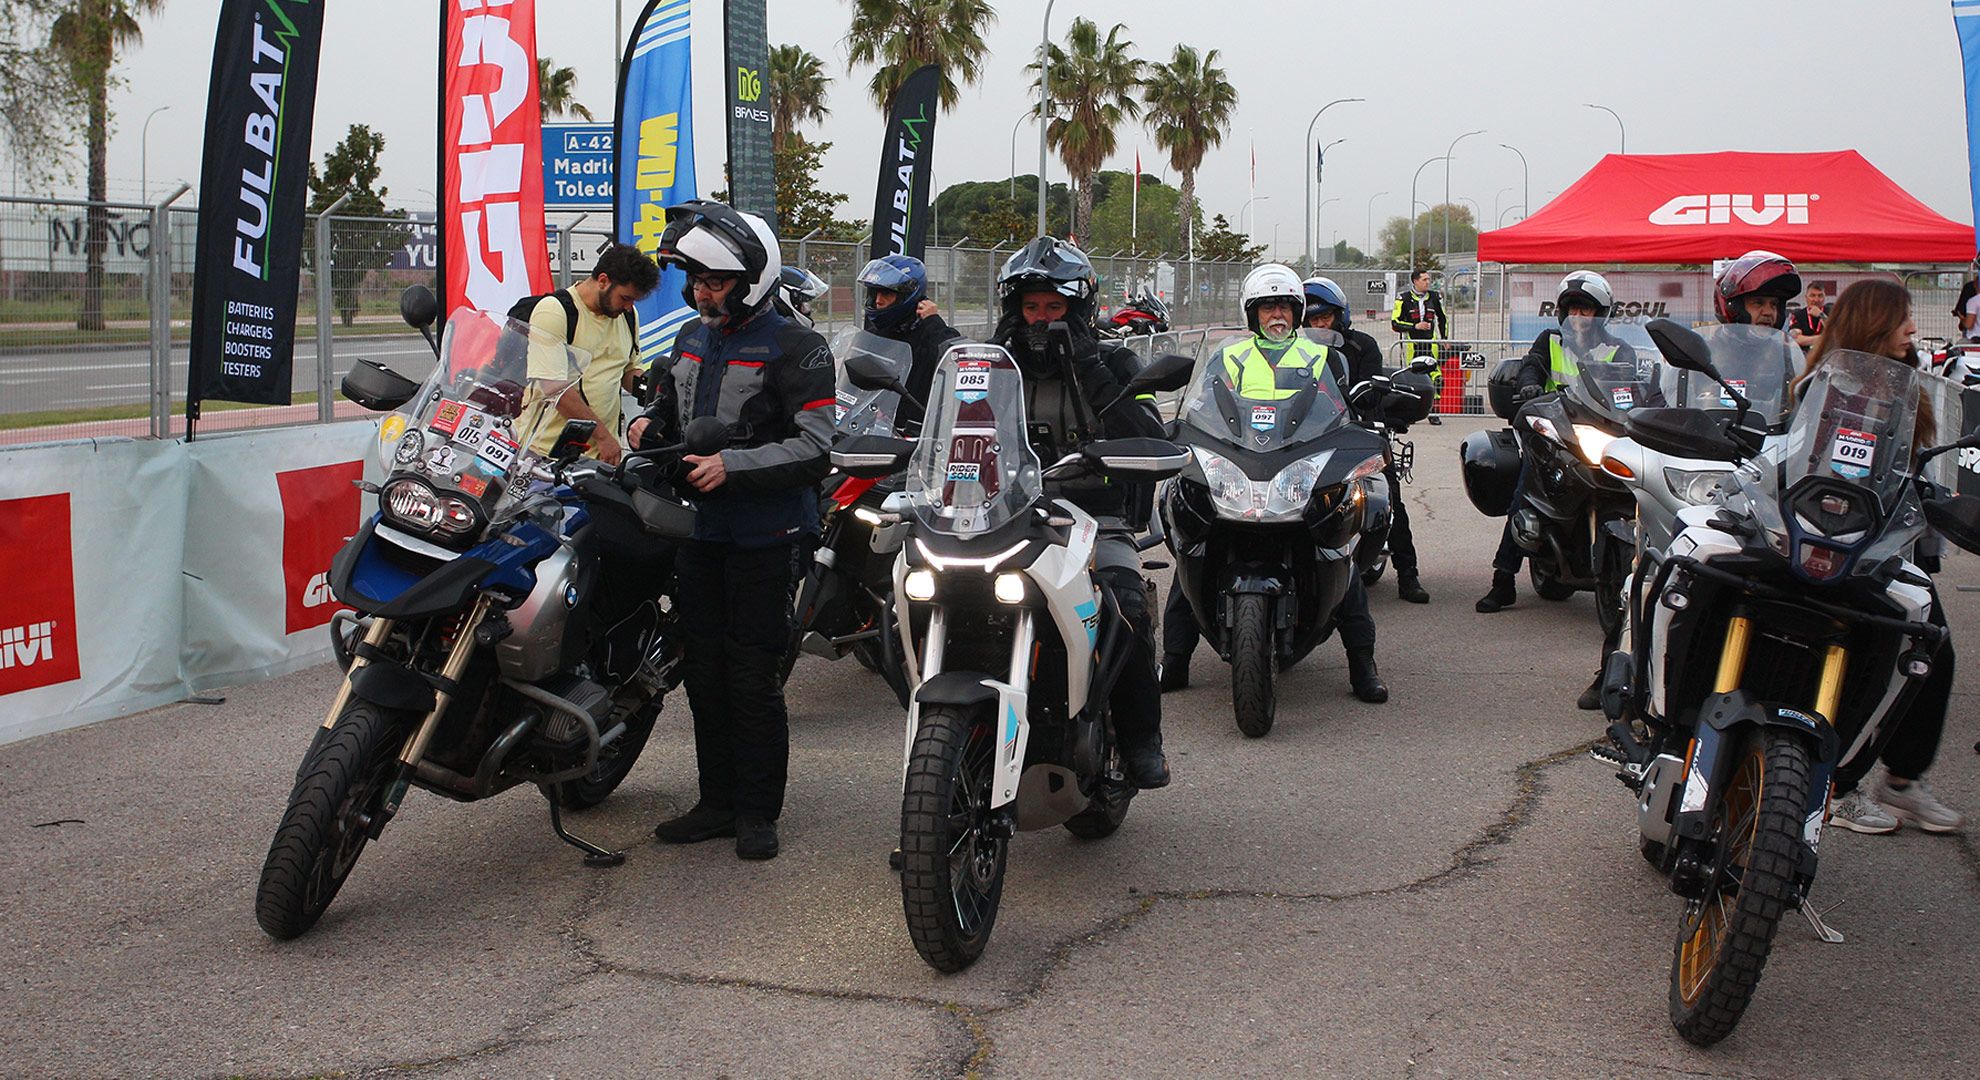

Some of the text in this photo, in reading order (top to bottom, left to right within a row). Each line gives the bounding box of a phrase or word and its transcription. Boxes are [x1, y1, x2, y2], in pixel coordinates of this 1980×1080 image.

[233, 22, 284, 279] FULBAT
[568, 135, 612, 150] A-42
[457, 0, 528, 318] GIV
[1649, 194, 1809, 226] GIVI
[228, 301, 274, 320] BATTERIES
[226, 321, 273, 340] CHARGERS
[225, 341, 272, 359] BOOSTERS
[223, 361, 261, 377] TESTERS
[960, 375, 985, 385] 085
[457, 427, 481, 444] 015
[485, 445, 509, 463] 091
[1840, 445, 1867, 459] 019
[0, 621, 53, 669] IVI
